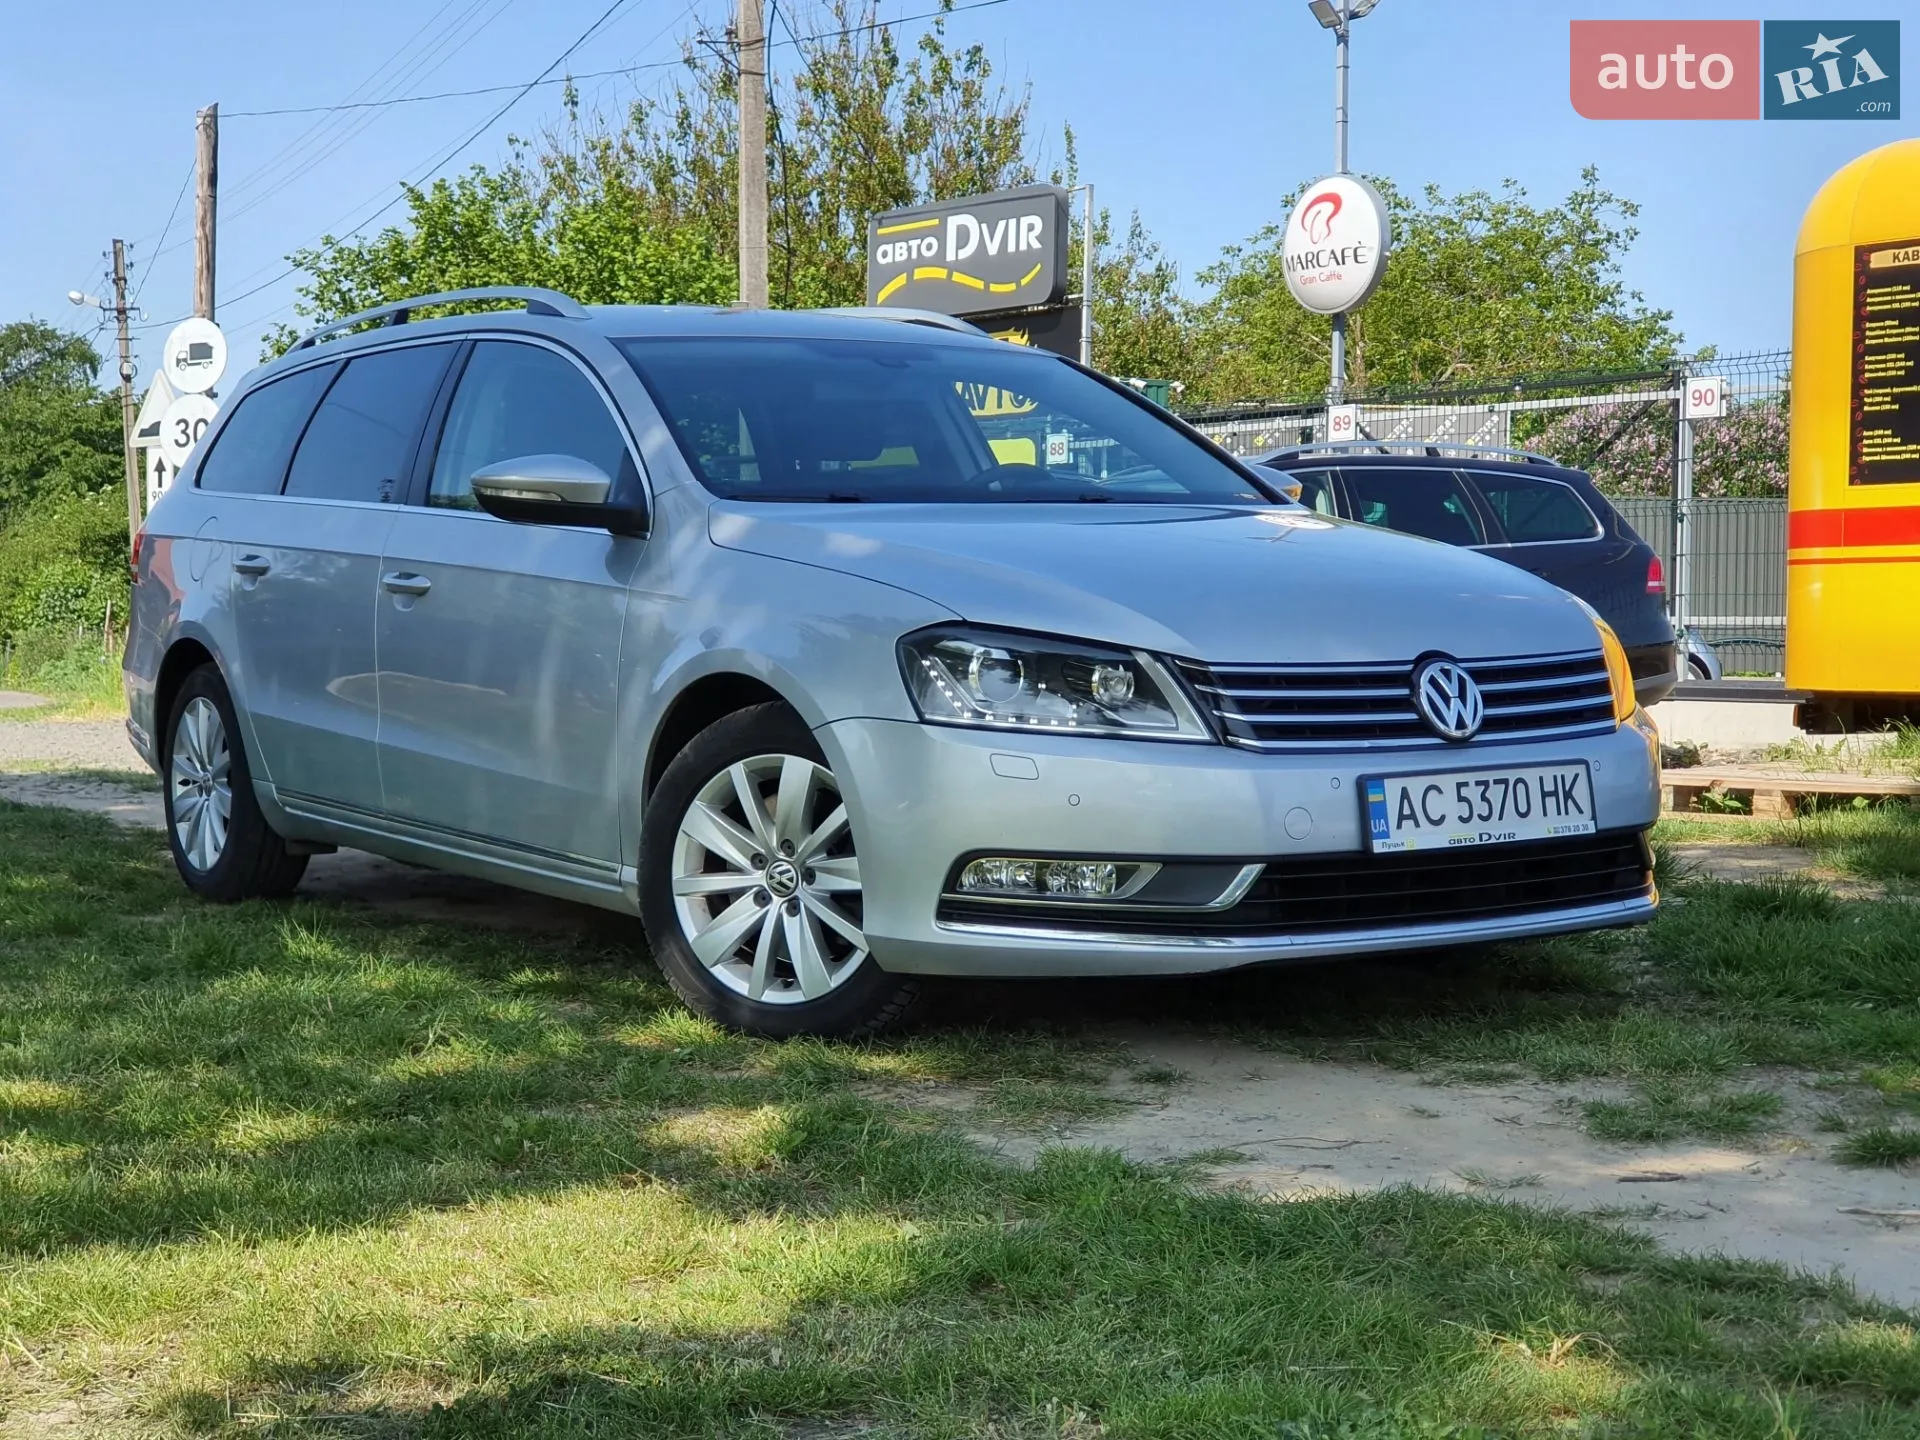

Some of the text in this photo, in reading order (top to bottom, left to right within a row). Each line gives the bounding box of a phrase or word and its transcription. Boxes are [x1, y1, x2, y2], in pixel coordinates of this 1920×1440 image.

[1300, 274, 1317, 285] Gran
[1692, 388, 1715, 407] 90
[1333, 415, 1351, 431] 89
[174, 418, 209, 448] 30
[1050, 442, 1064, 456] 88
[1396, 772, 1585, 830] AC 5370 HK
[1371, 818, 1388, 833] UA
